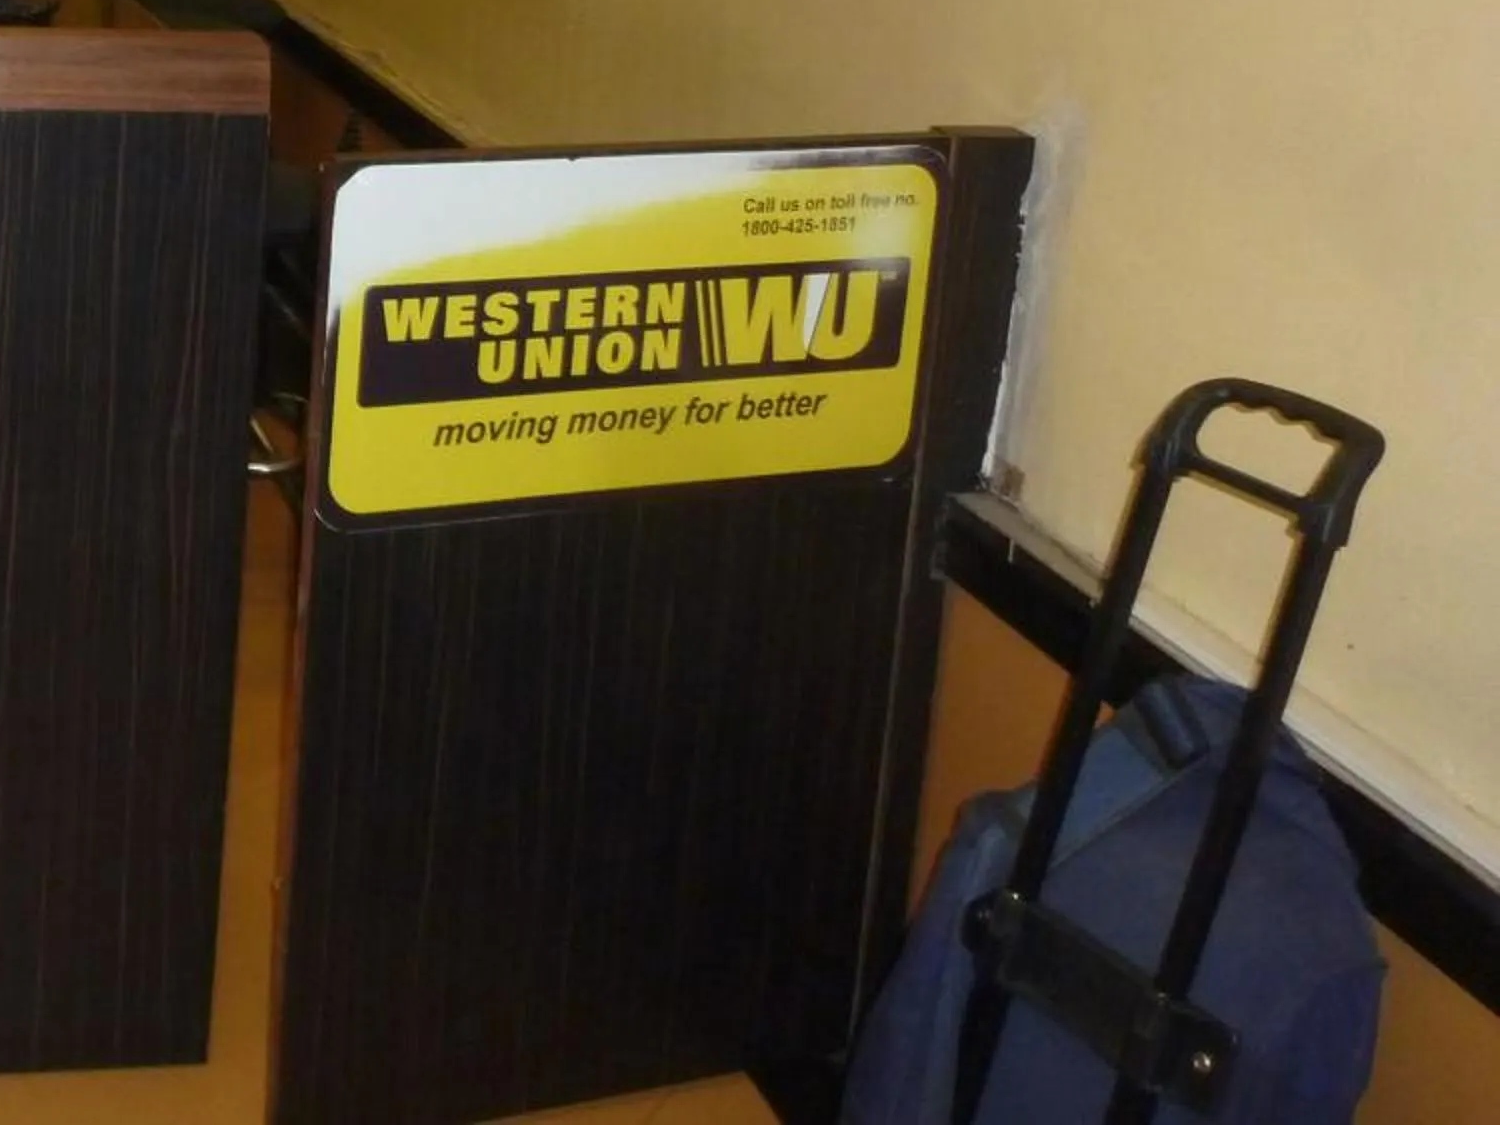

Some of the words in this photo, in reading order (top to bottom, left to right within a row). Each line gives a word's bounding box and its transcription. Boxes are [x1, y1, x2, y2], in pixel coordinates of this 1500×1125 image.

[742, 216, 856, 237] 1800-425-1851
[743, 197, 776, 214] Call
[780, 199, 799, 212] us
[805, 197, 825, 211] on
[830, 193, 855, 210] toll
[860, 192, 891, 208] free
[382, 281, 687, 343] WESTERN
[719, 270, 881, 365] WU
[476, 328, 682, 385] UNION
[432, 411, 557, 448] moving
[566, 402, 675, 439] money
[682, 395, 729, 427] for
[736, 389, 828, 422] better
